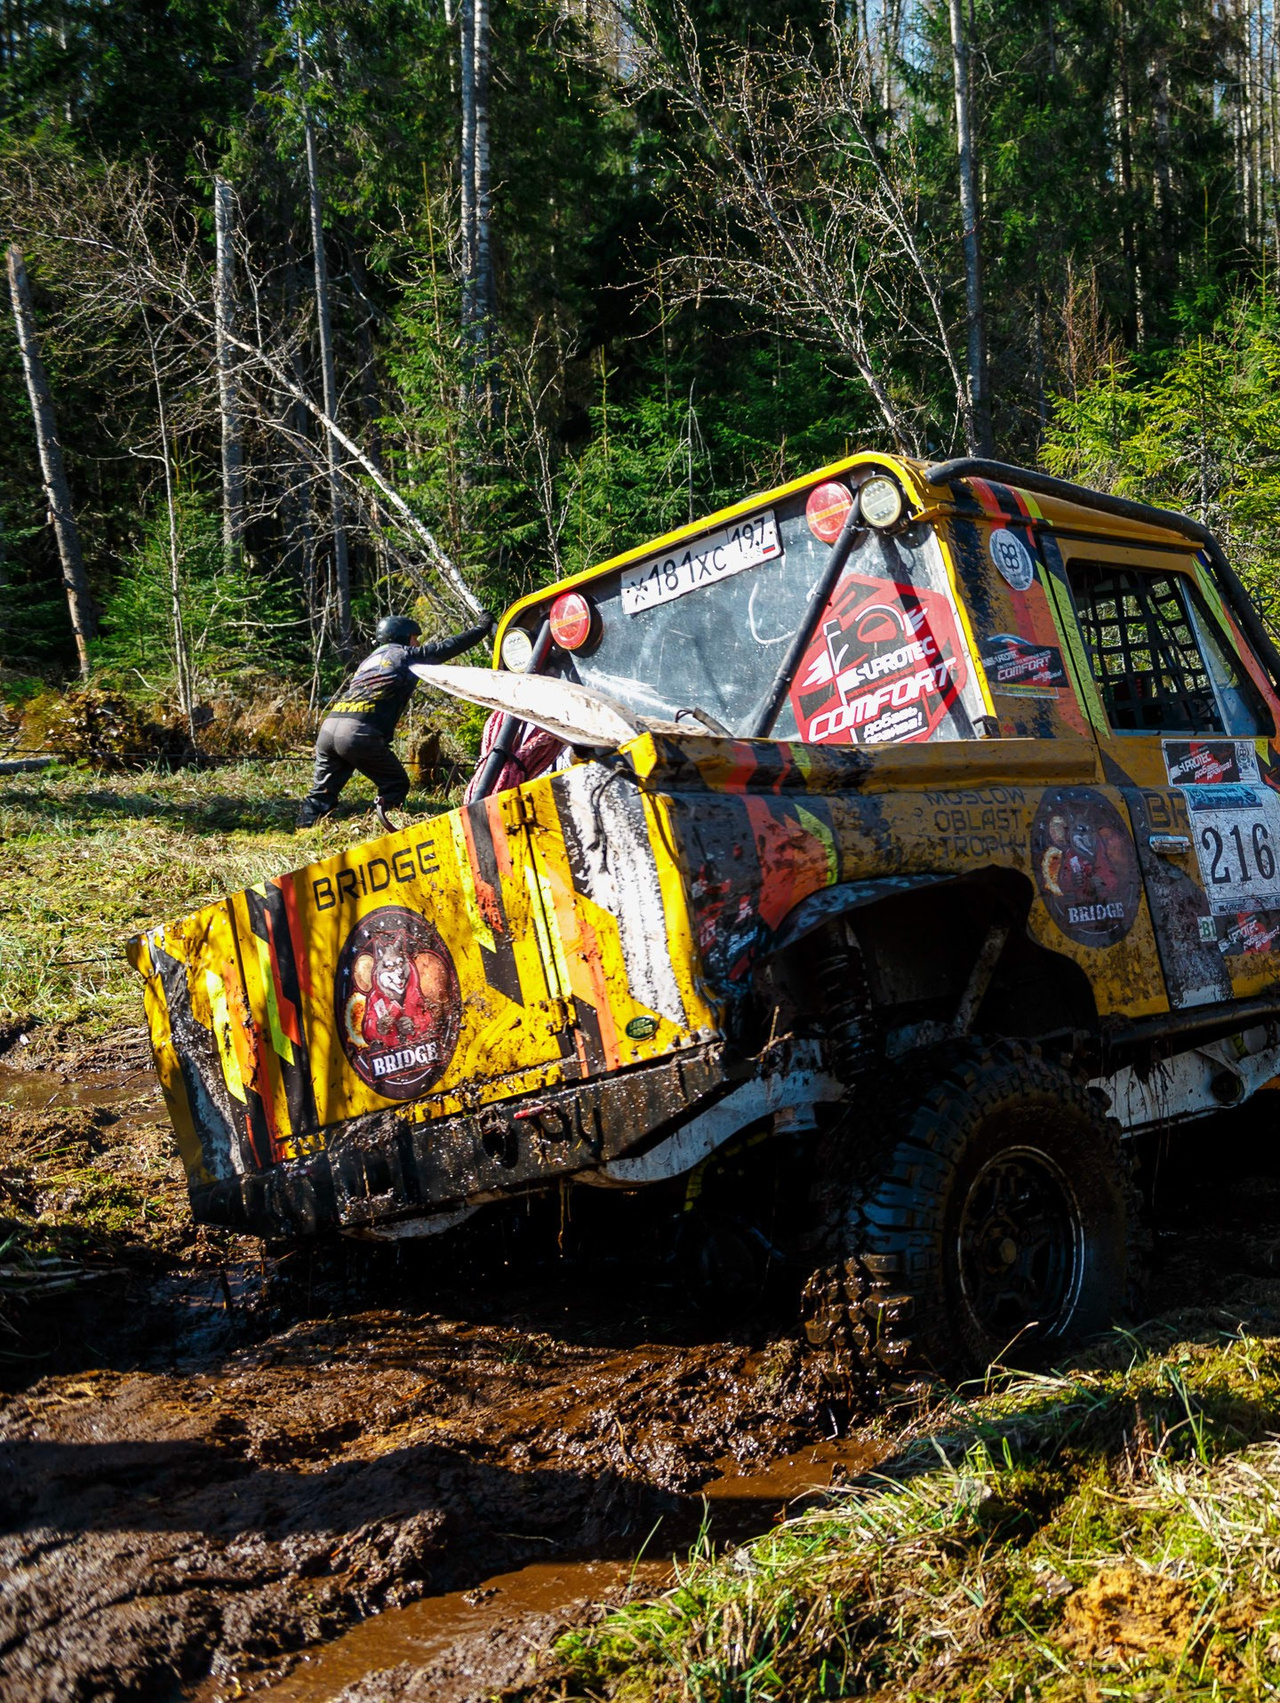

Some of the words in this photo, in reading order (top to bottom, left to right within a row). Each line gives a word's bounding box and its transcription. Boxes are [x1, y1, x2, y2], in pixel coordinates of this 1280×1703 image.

[731, 517, 765, 553] 197
[997, 655, 1052, 681] COMFORT
[808, 657, 958, 742] COMFORT
[923, 787, 1026, 806] MOSCOW
[934, 808, 1021, 833] OBLAST
[1201, 823, 1276, 884] 216
[312, 839, 440, 911] BRIDGE
[1068, 902, 1124, 924] BRIDGE
[372, 1042, 440, 1077] BRIDGE
